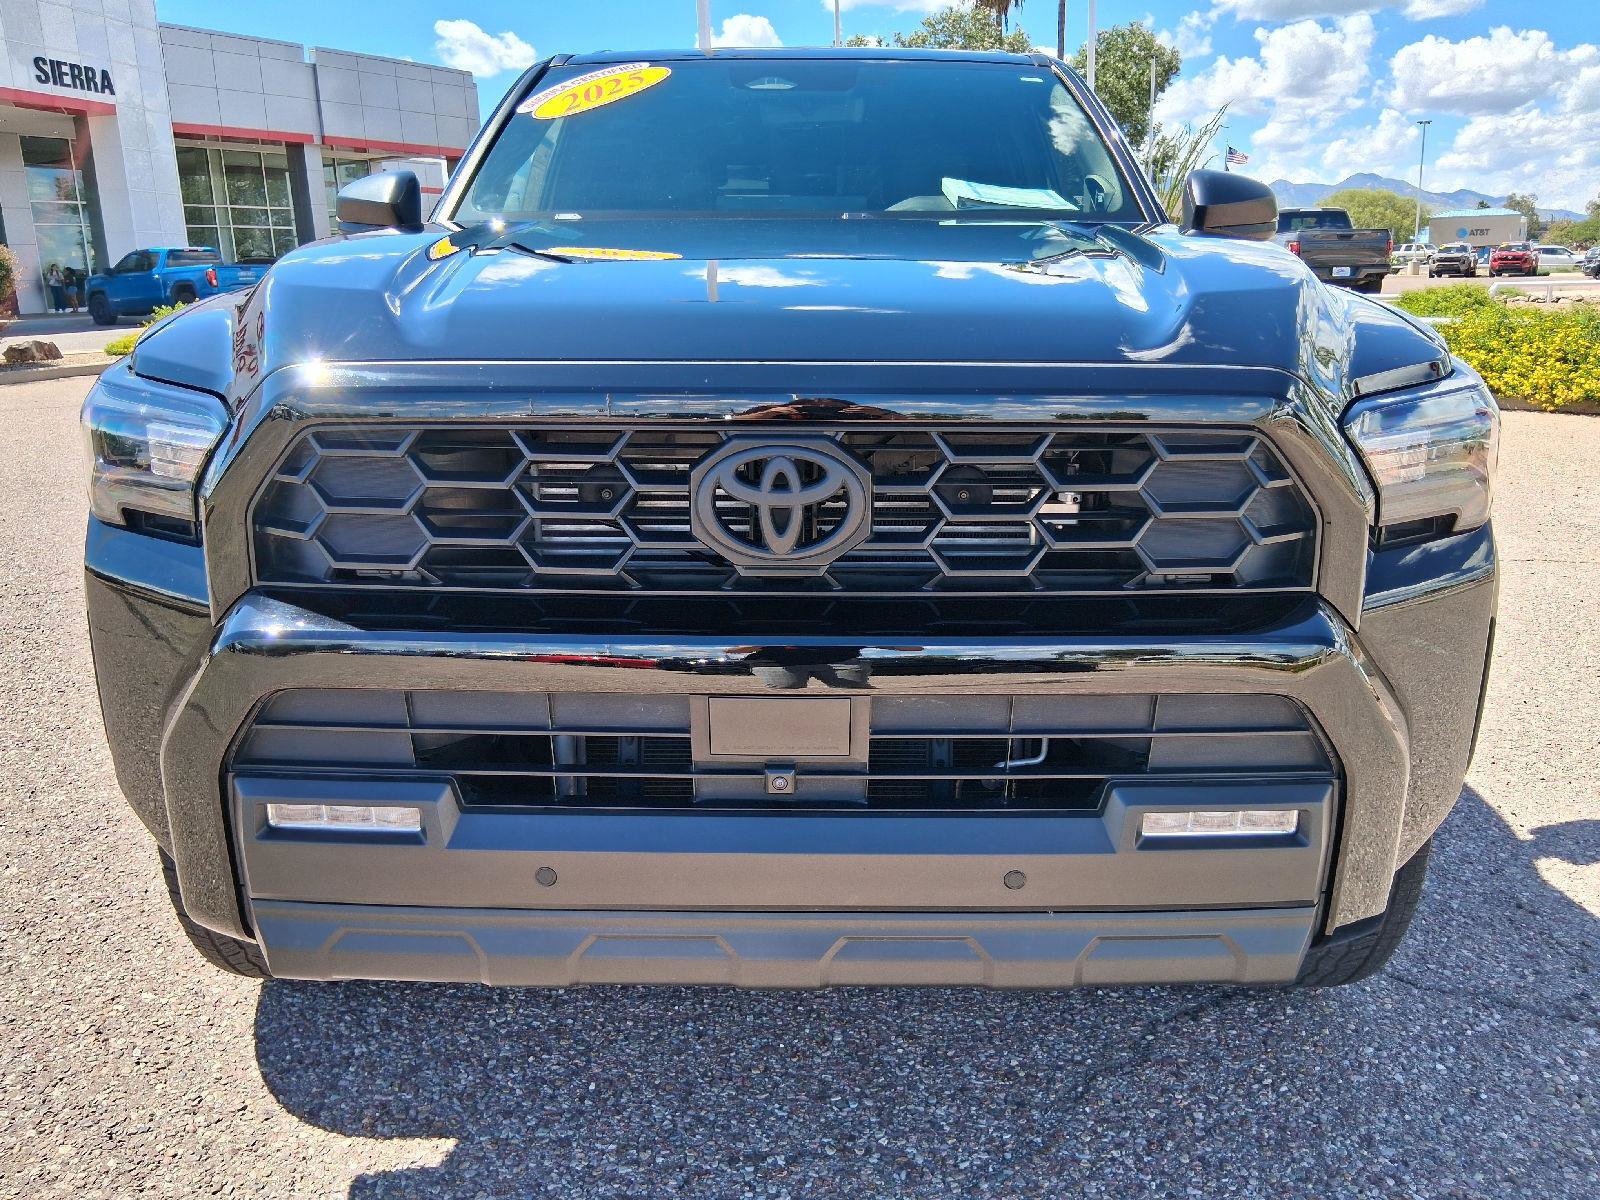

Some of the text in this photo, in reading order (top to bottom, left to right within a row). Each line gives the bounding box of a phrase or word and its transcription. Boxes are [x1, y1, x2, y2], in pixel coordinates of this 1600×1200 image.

[33, 56, 115, 95] SIERRA
[561, 71, 645, 115] 2025
[1469, 228, 1491, 237] AT&T
